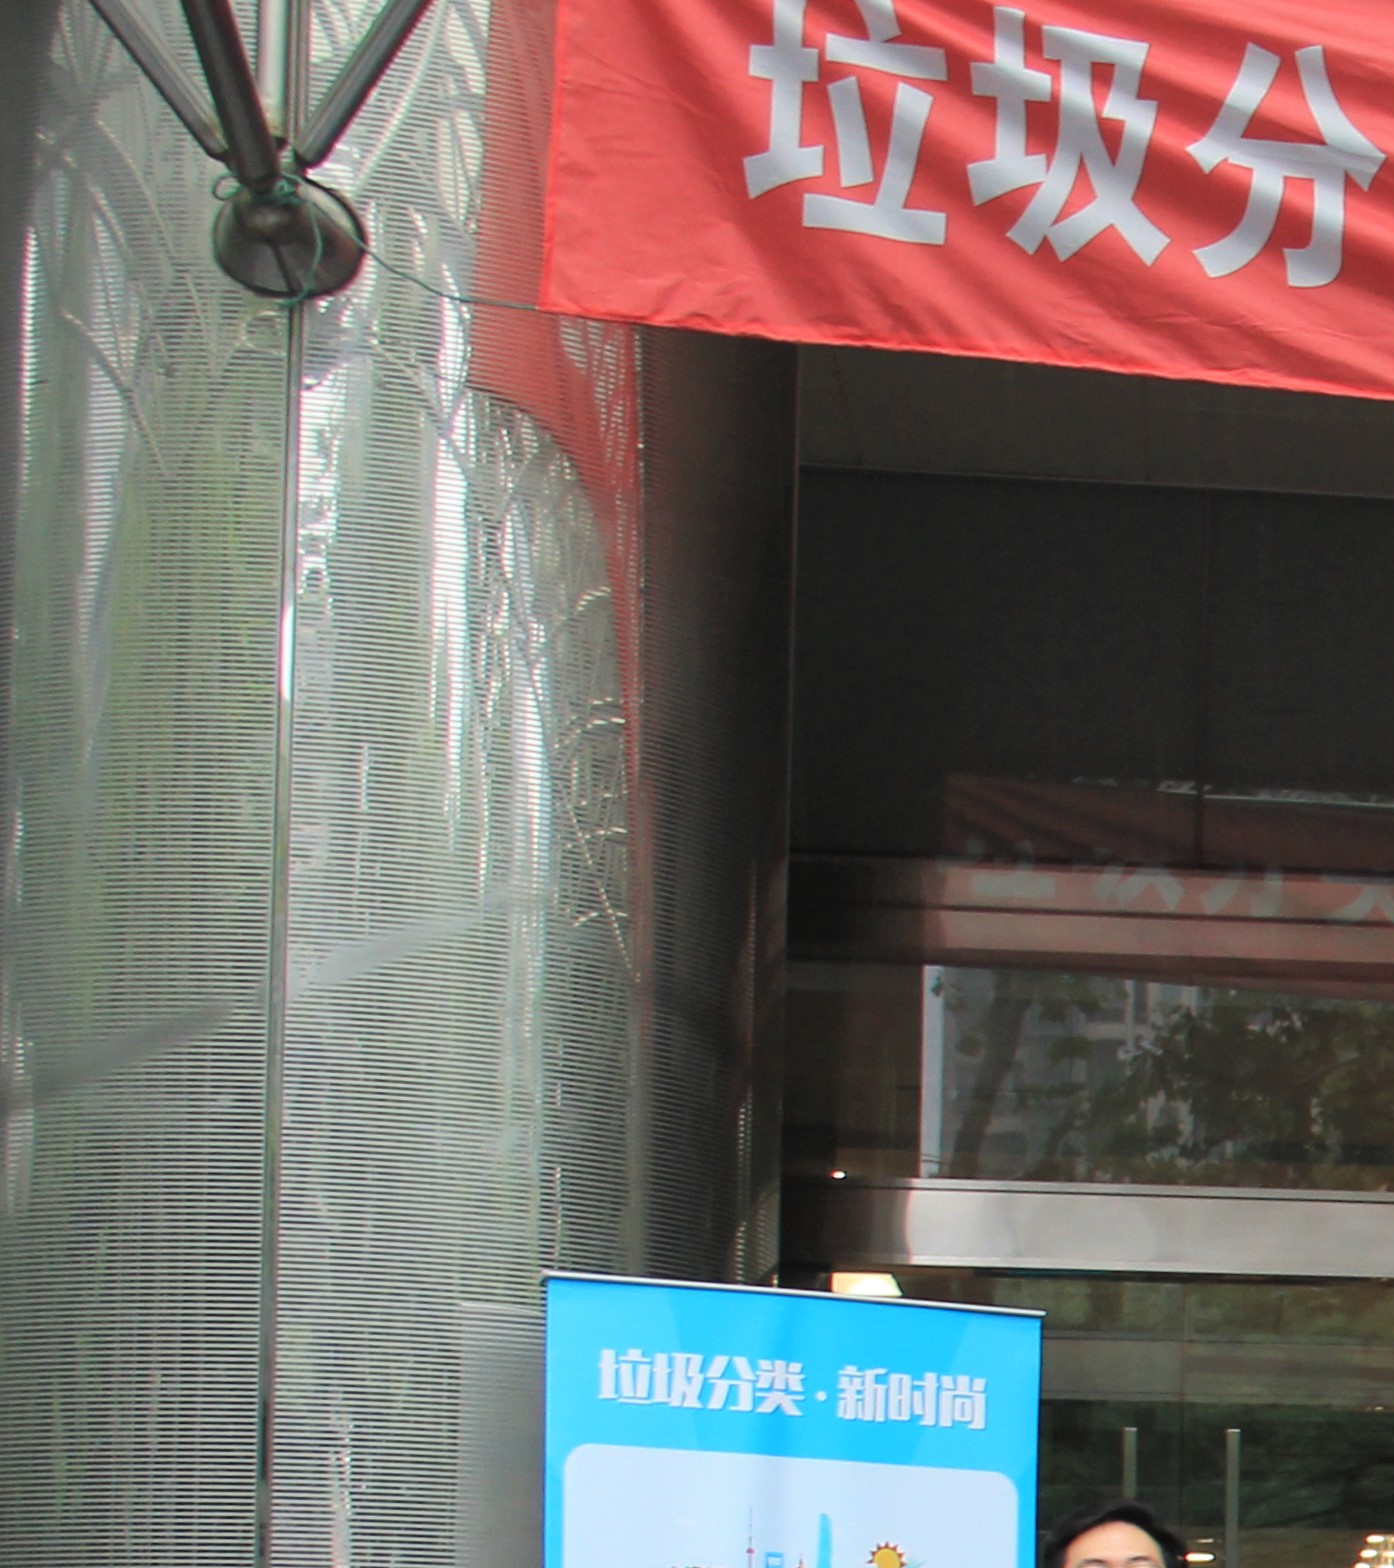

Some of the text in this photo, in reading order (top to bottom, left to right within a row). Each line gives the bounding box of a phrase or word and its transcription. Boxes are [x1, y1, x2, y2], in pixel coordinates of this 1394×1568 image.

[597, 1346, 988, 1431] 垃圾分类·新时尚
